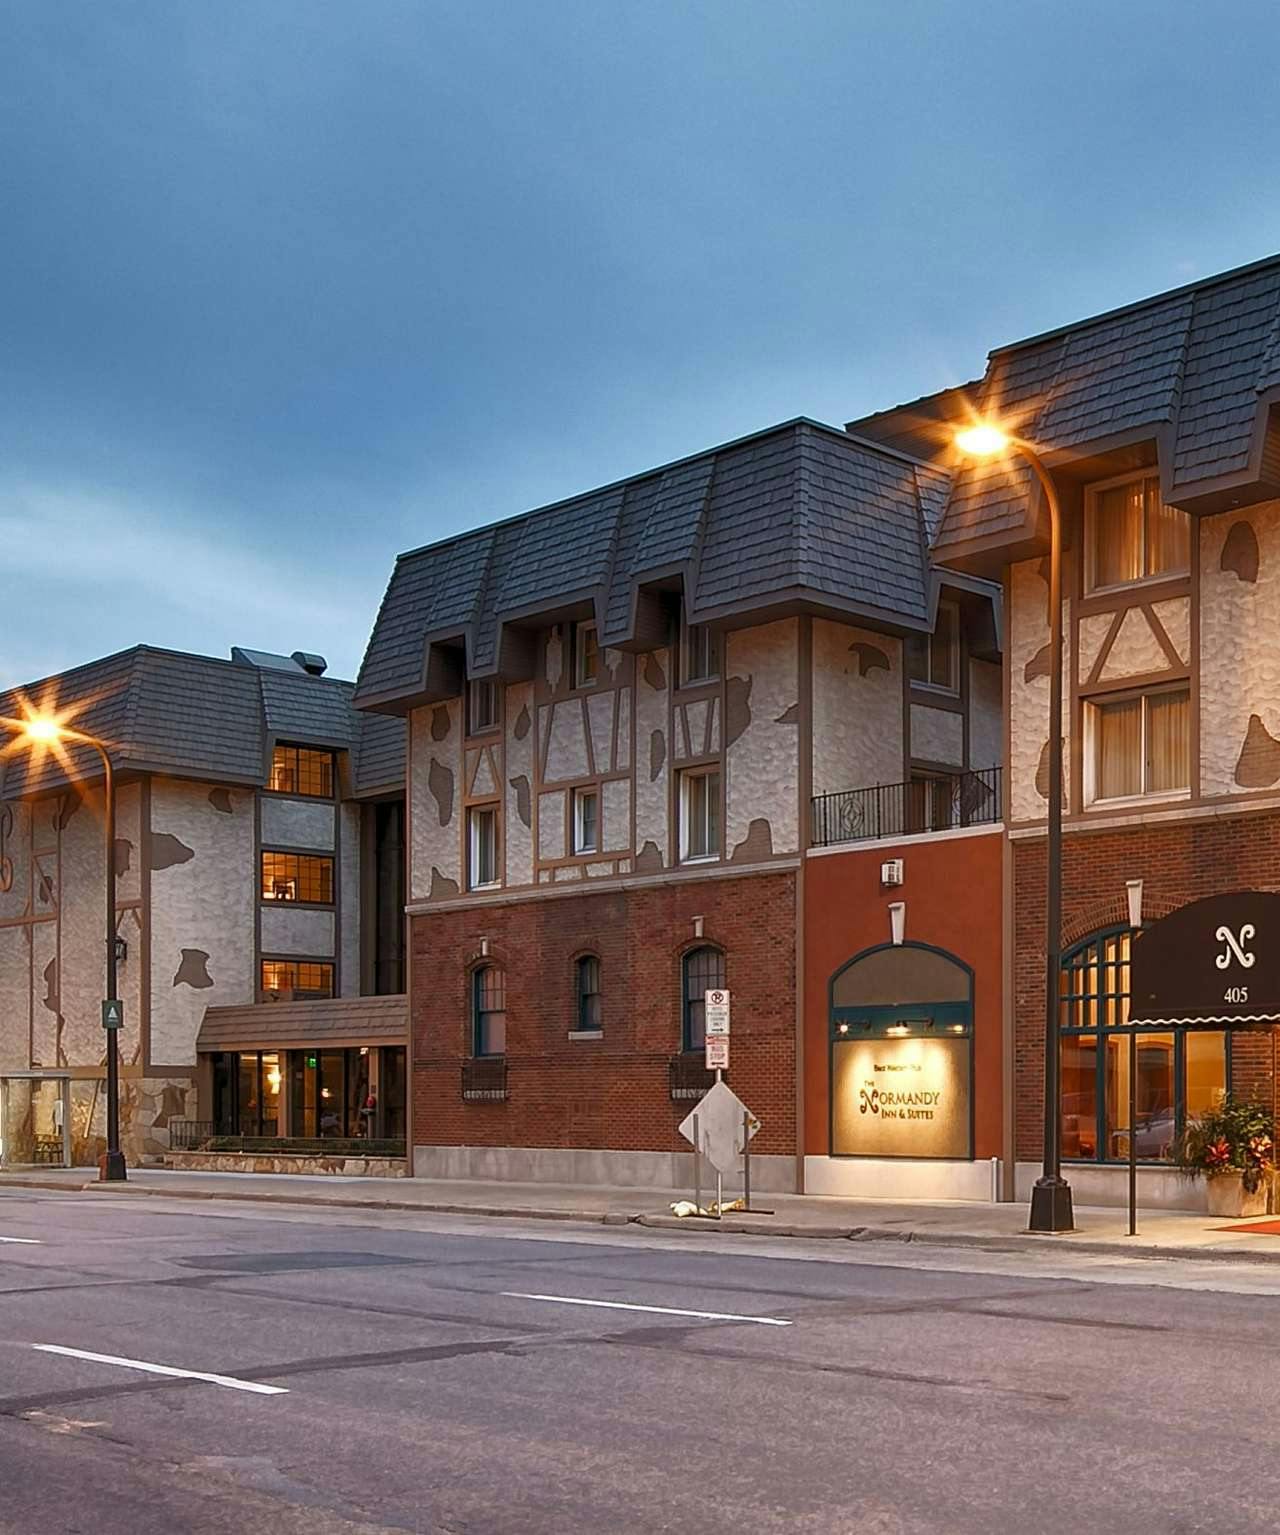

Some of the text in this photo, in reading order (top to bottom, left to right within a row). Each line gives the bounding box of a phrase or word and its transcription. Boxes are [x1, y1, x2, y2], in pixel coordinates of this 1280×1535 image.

[1215, 924, 1255, 969] N
[1223, 987, 1248, 1004] 405
[860, 1089, 940, 1114] NORMANDY
[881, 1109, 896, 1119] INN
[899, 1109, 906, 1119] &
